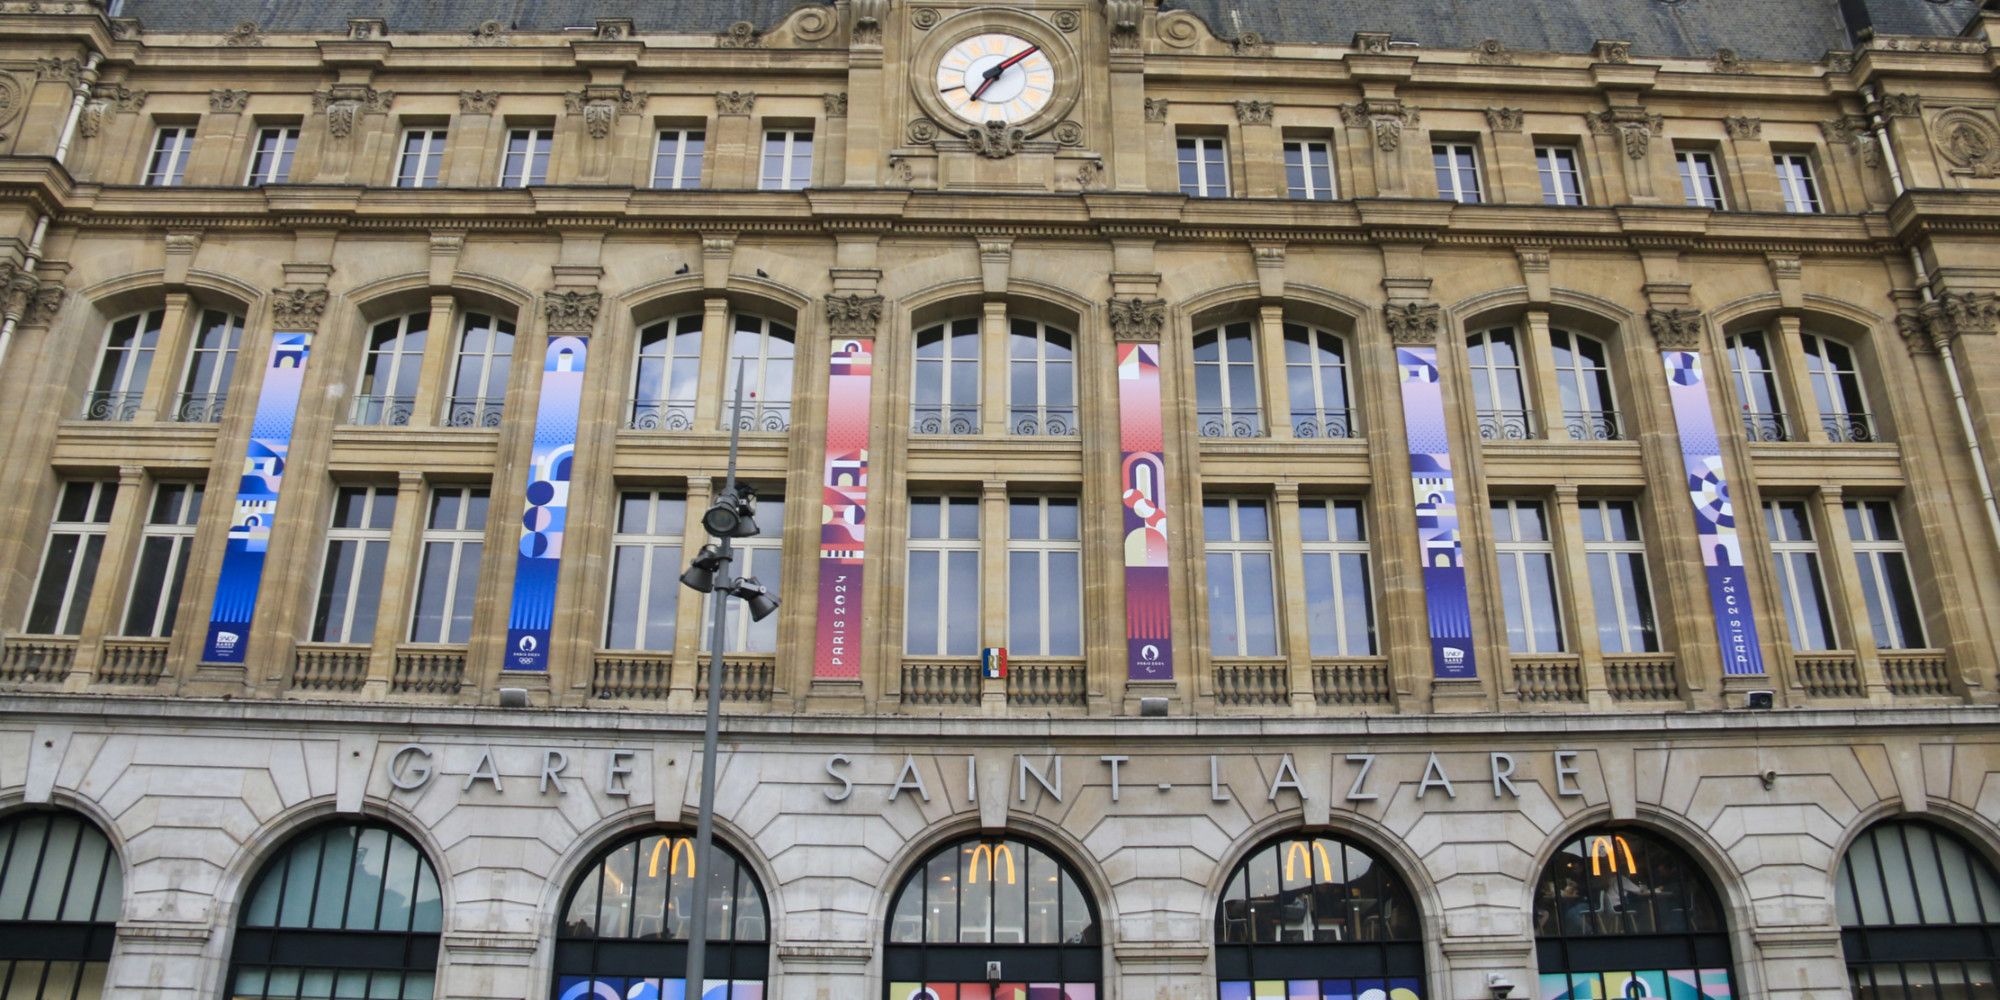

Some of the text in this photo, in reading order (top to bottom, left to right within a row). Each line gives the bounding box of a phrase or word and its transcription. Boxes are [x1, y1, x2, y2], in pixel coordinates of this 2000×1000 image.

[832, 575, 848, 665] PARIS 2024
[1723, 576, 1747, 663] PARIS 2024
[387, 743, 1584, 803] GARE SAINT-LAZARE
